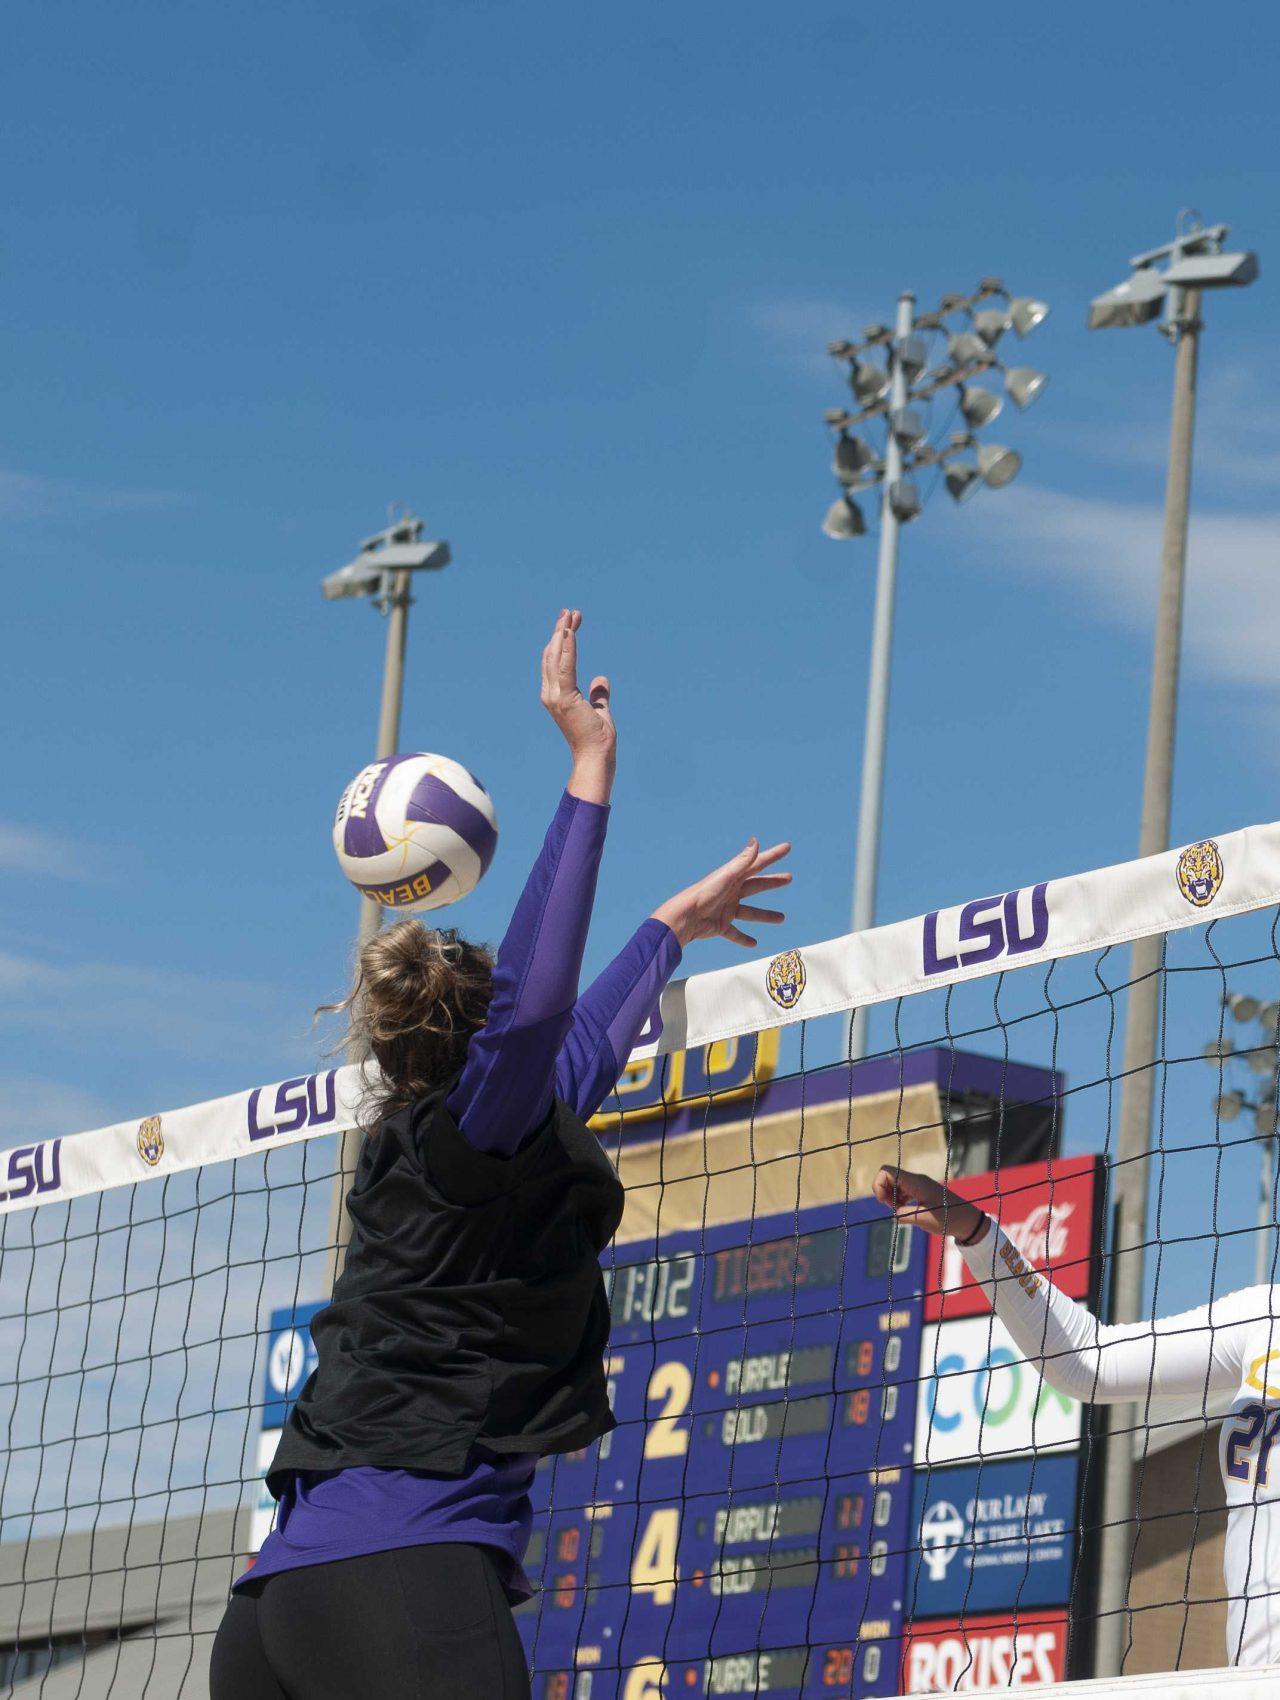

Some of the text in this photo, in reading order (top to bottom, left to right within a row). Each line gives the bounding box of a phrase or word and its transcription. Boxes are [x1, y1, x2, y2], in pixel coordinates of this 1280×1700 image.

[924, 882, 1049, 976] LSU
[247, 1069, 336, 1142] LSU
[713, 1238, 812, 1299] TIGERS
[725, 1352, 790, 1396] PURPLE
[885, 1335, 901, 1372] 0
[645, 1361, 693, 1460] 2
[722, 1406, 769, 1446] GOLD
[713, 1505, 783, 1545] PURPLE
[874, 1490, 892, 1527] 0
[1003, 1493, 1047, 1519] LADY
[632, 1508, 680, 1605] 4
[710, 1557, 756, 1597] GOLD
[871, 1540, 887, 1577] 0
[704, 1655, 774, 1695] PURPLE
[863, 1646, 881, 1683] 0
[909, 1632, 1056, 1693] ROUSES
